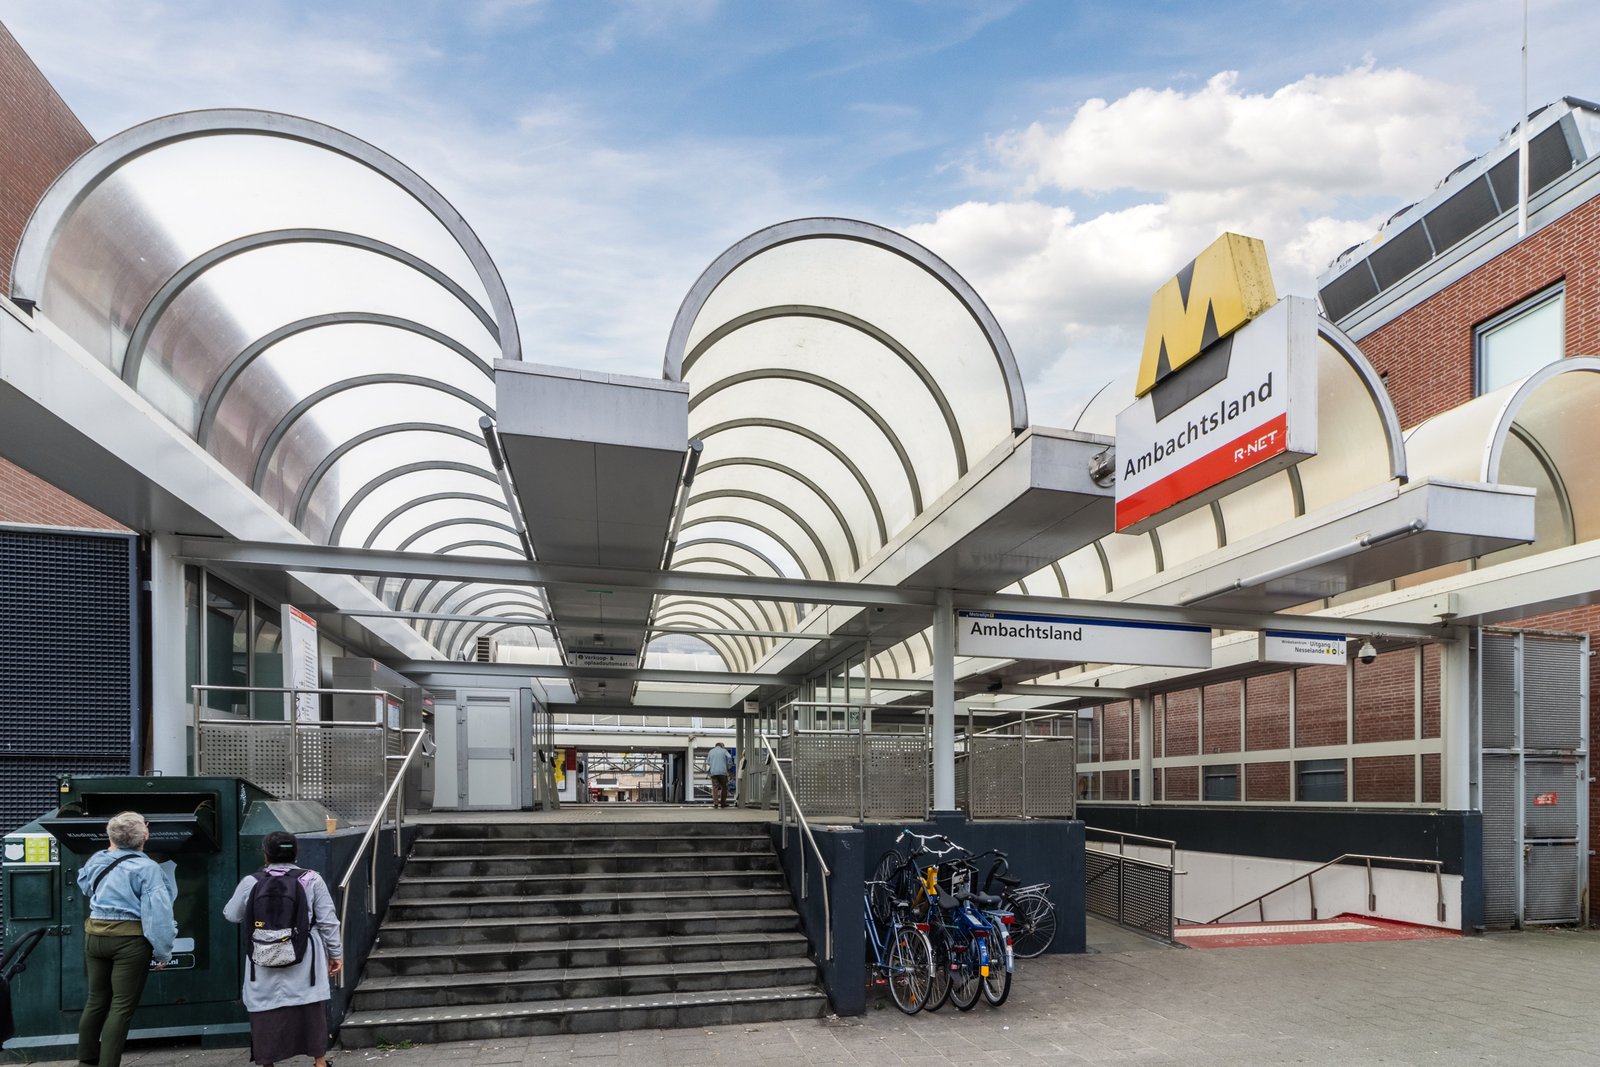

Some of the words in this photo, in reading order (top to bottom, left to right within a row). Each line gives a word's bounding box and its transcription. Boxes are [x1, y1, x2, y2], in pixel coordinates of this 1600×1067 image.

[1135, 232, 1251, 398] M
[1123, 371, 1273, 481] Ambachtsland
[970, 621, 1082, 641] Ambachtsland
